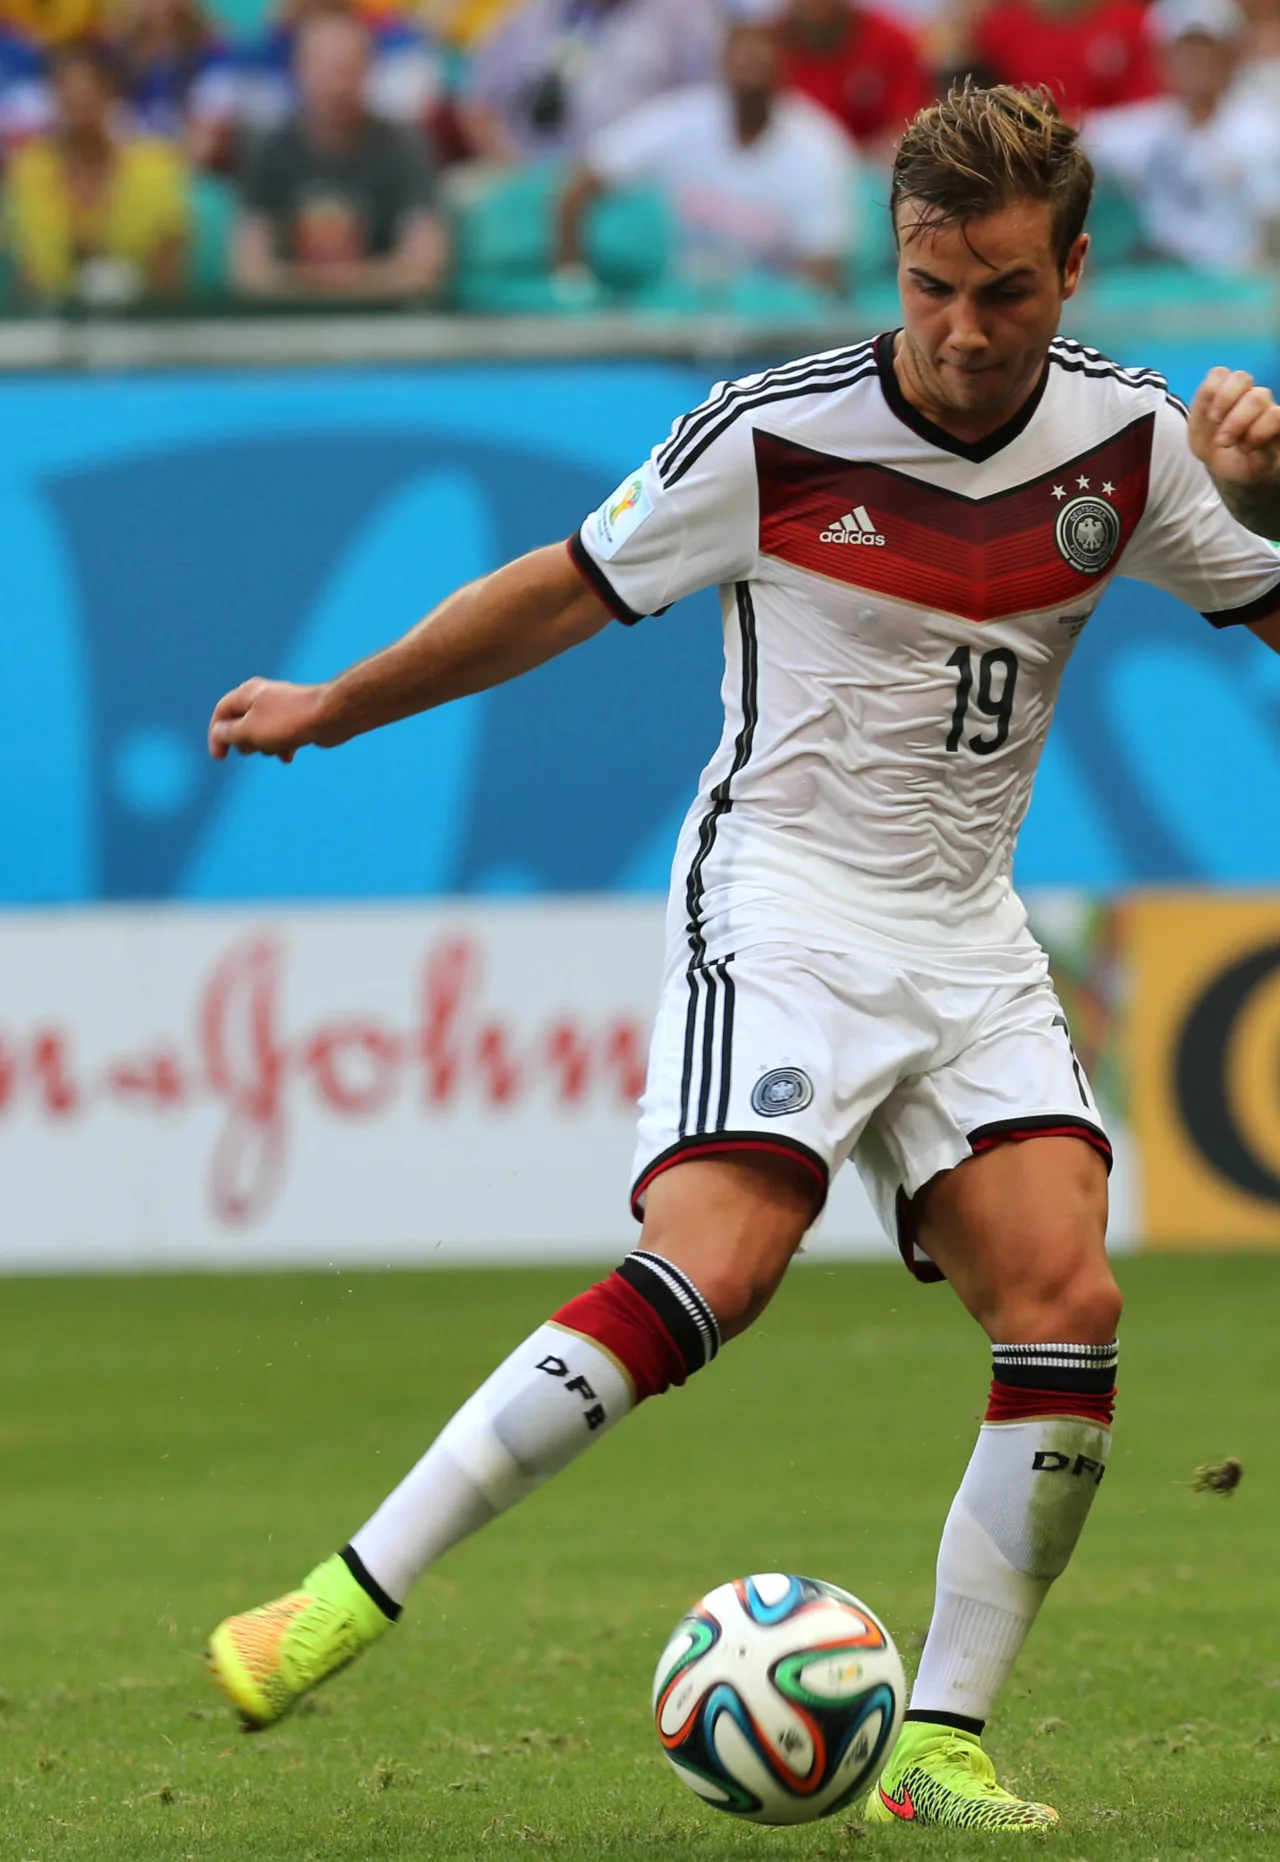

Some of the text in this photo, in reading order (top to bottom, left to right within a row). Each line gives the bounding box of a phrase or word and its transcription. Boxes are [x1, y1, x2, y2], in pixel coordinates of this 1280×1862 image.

[819, 529, 886, 547] adidas
[945, 646, 1018, 756] 19
[535, 1354, 606, 1431] DFB
[1031, 1451, 1106, 1486] DF
